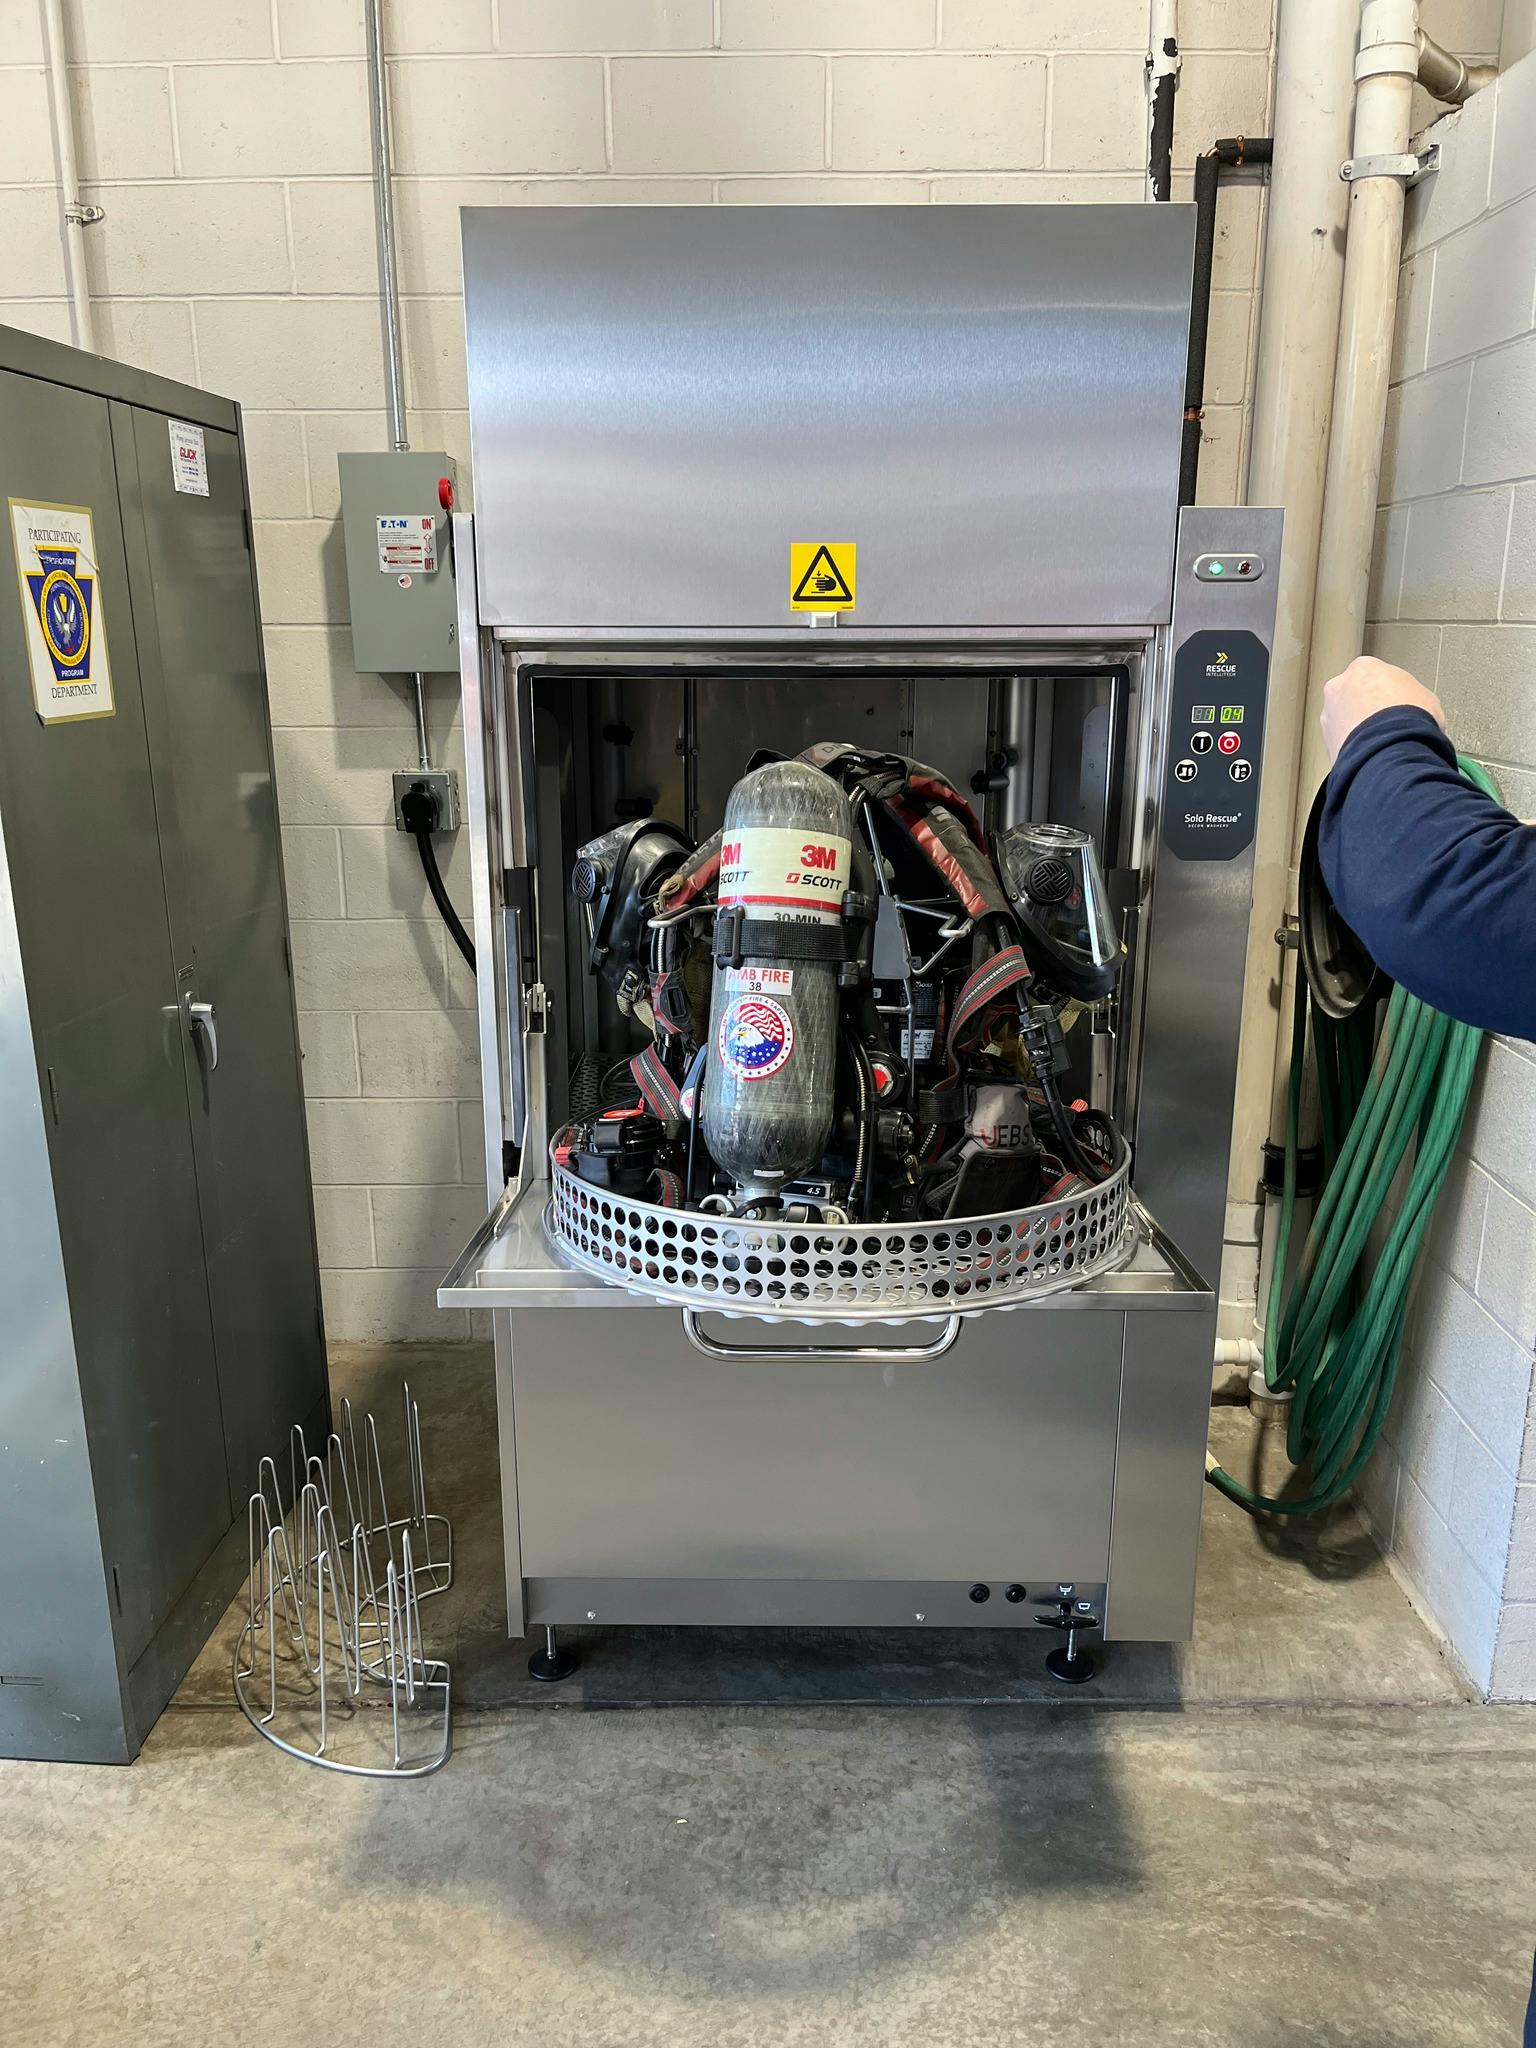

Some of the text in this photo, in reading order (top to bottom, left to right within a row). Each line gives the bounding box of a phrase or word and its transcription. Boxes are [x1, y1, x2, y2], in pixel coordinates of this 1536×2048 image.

[422, 518, 431, 529] ON
[28, 527, 81, 544] PARTICIPATING
[425, 557, 434, 570] OFF
[61, 669, 84, 677] PROGRAM
[1206, 665, 1237, 673] RESCUE
[51, 683, 97, 699] DEPARTMENT
[1223, 708, 1242, 721] 04
[1184, 813, 1204, 823] Solo
[800, 844, 837, 871] 3M
[801, 874, 843, 891] SCOTT
[761, 969, 790, 983] FIRE
[749, 981, 762, 991] 38
[807, 1187, 821, 1195] 4.5
